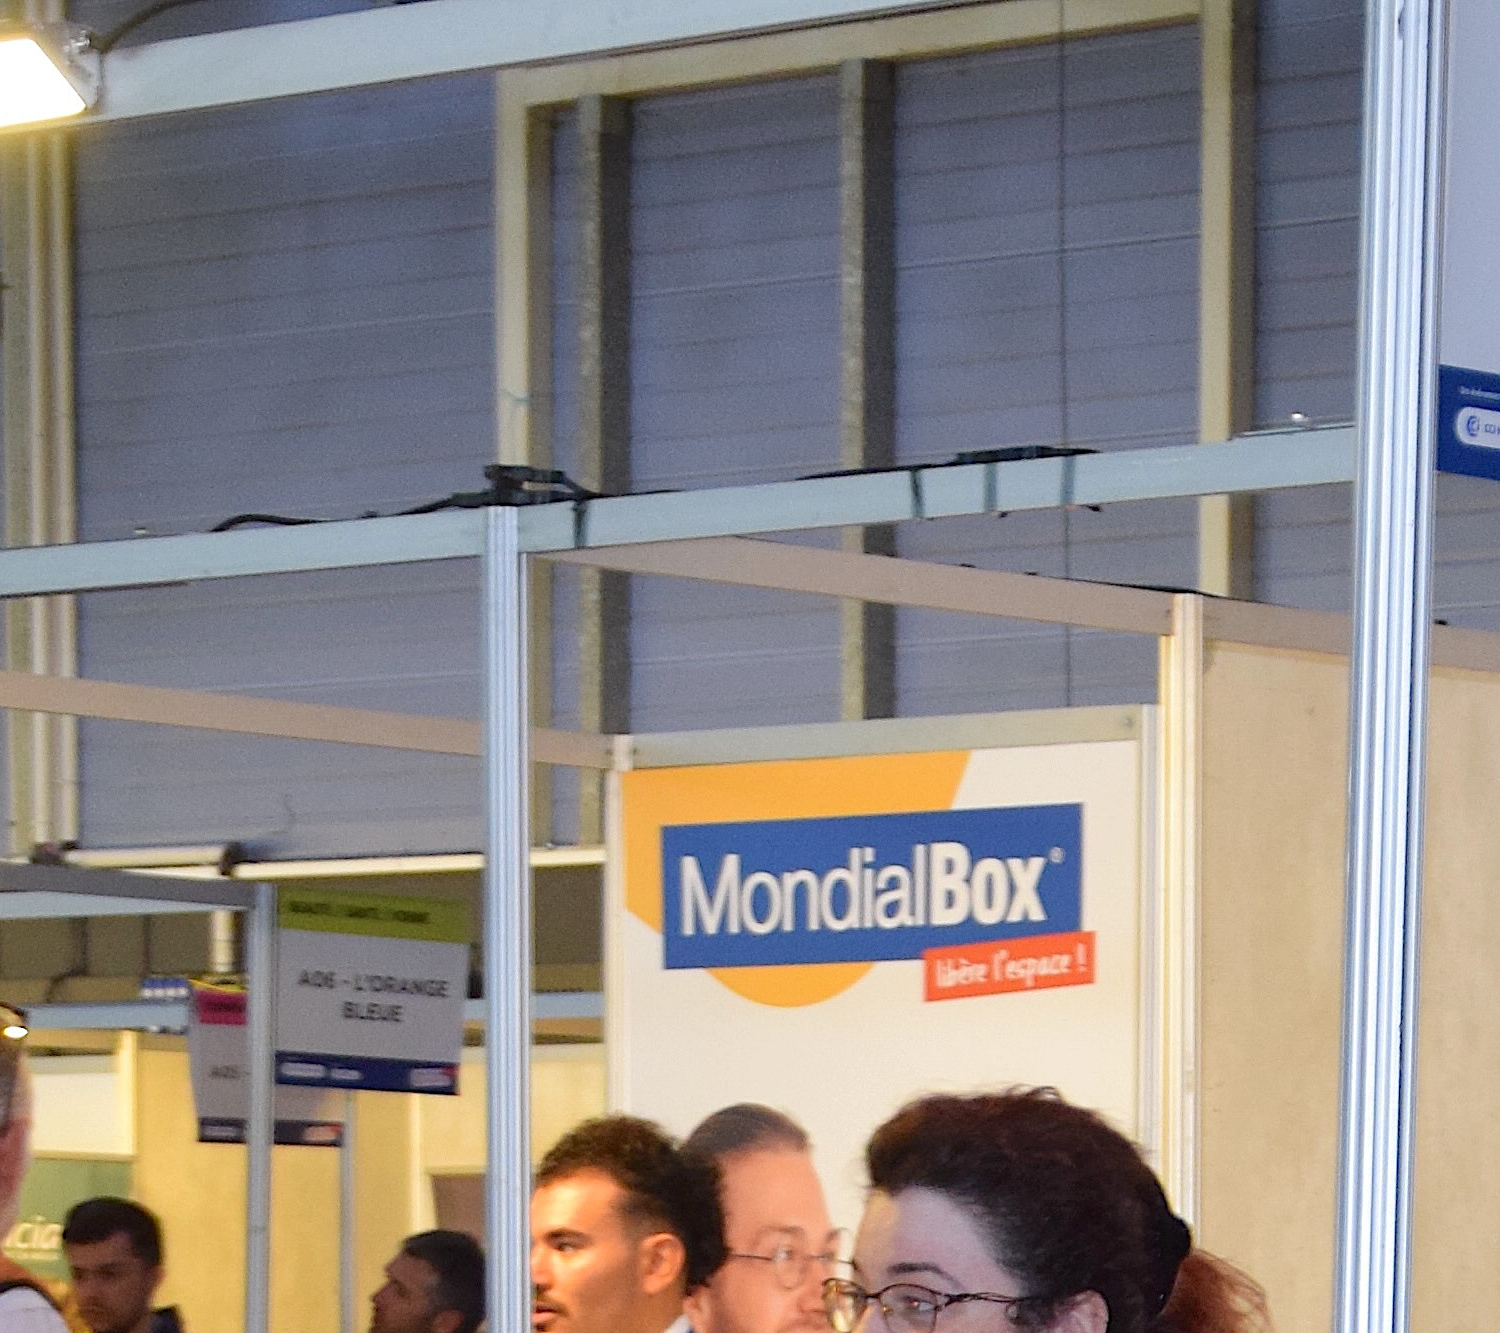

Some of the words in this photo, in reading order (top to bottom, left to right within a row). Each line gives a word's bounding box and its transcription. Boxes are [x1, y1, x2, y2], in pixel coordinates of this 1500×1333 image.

[935, 957, 988, 989] libère
[995, 948, 1071, 986] l'espace
[343, 1001, 403, 1023] BLEUE
